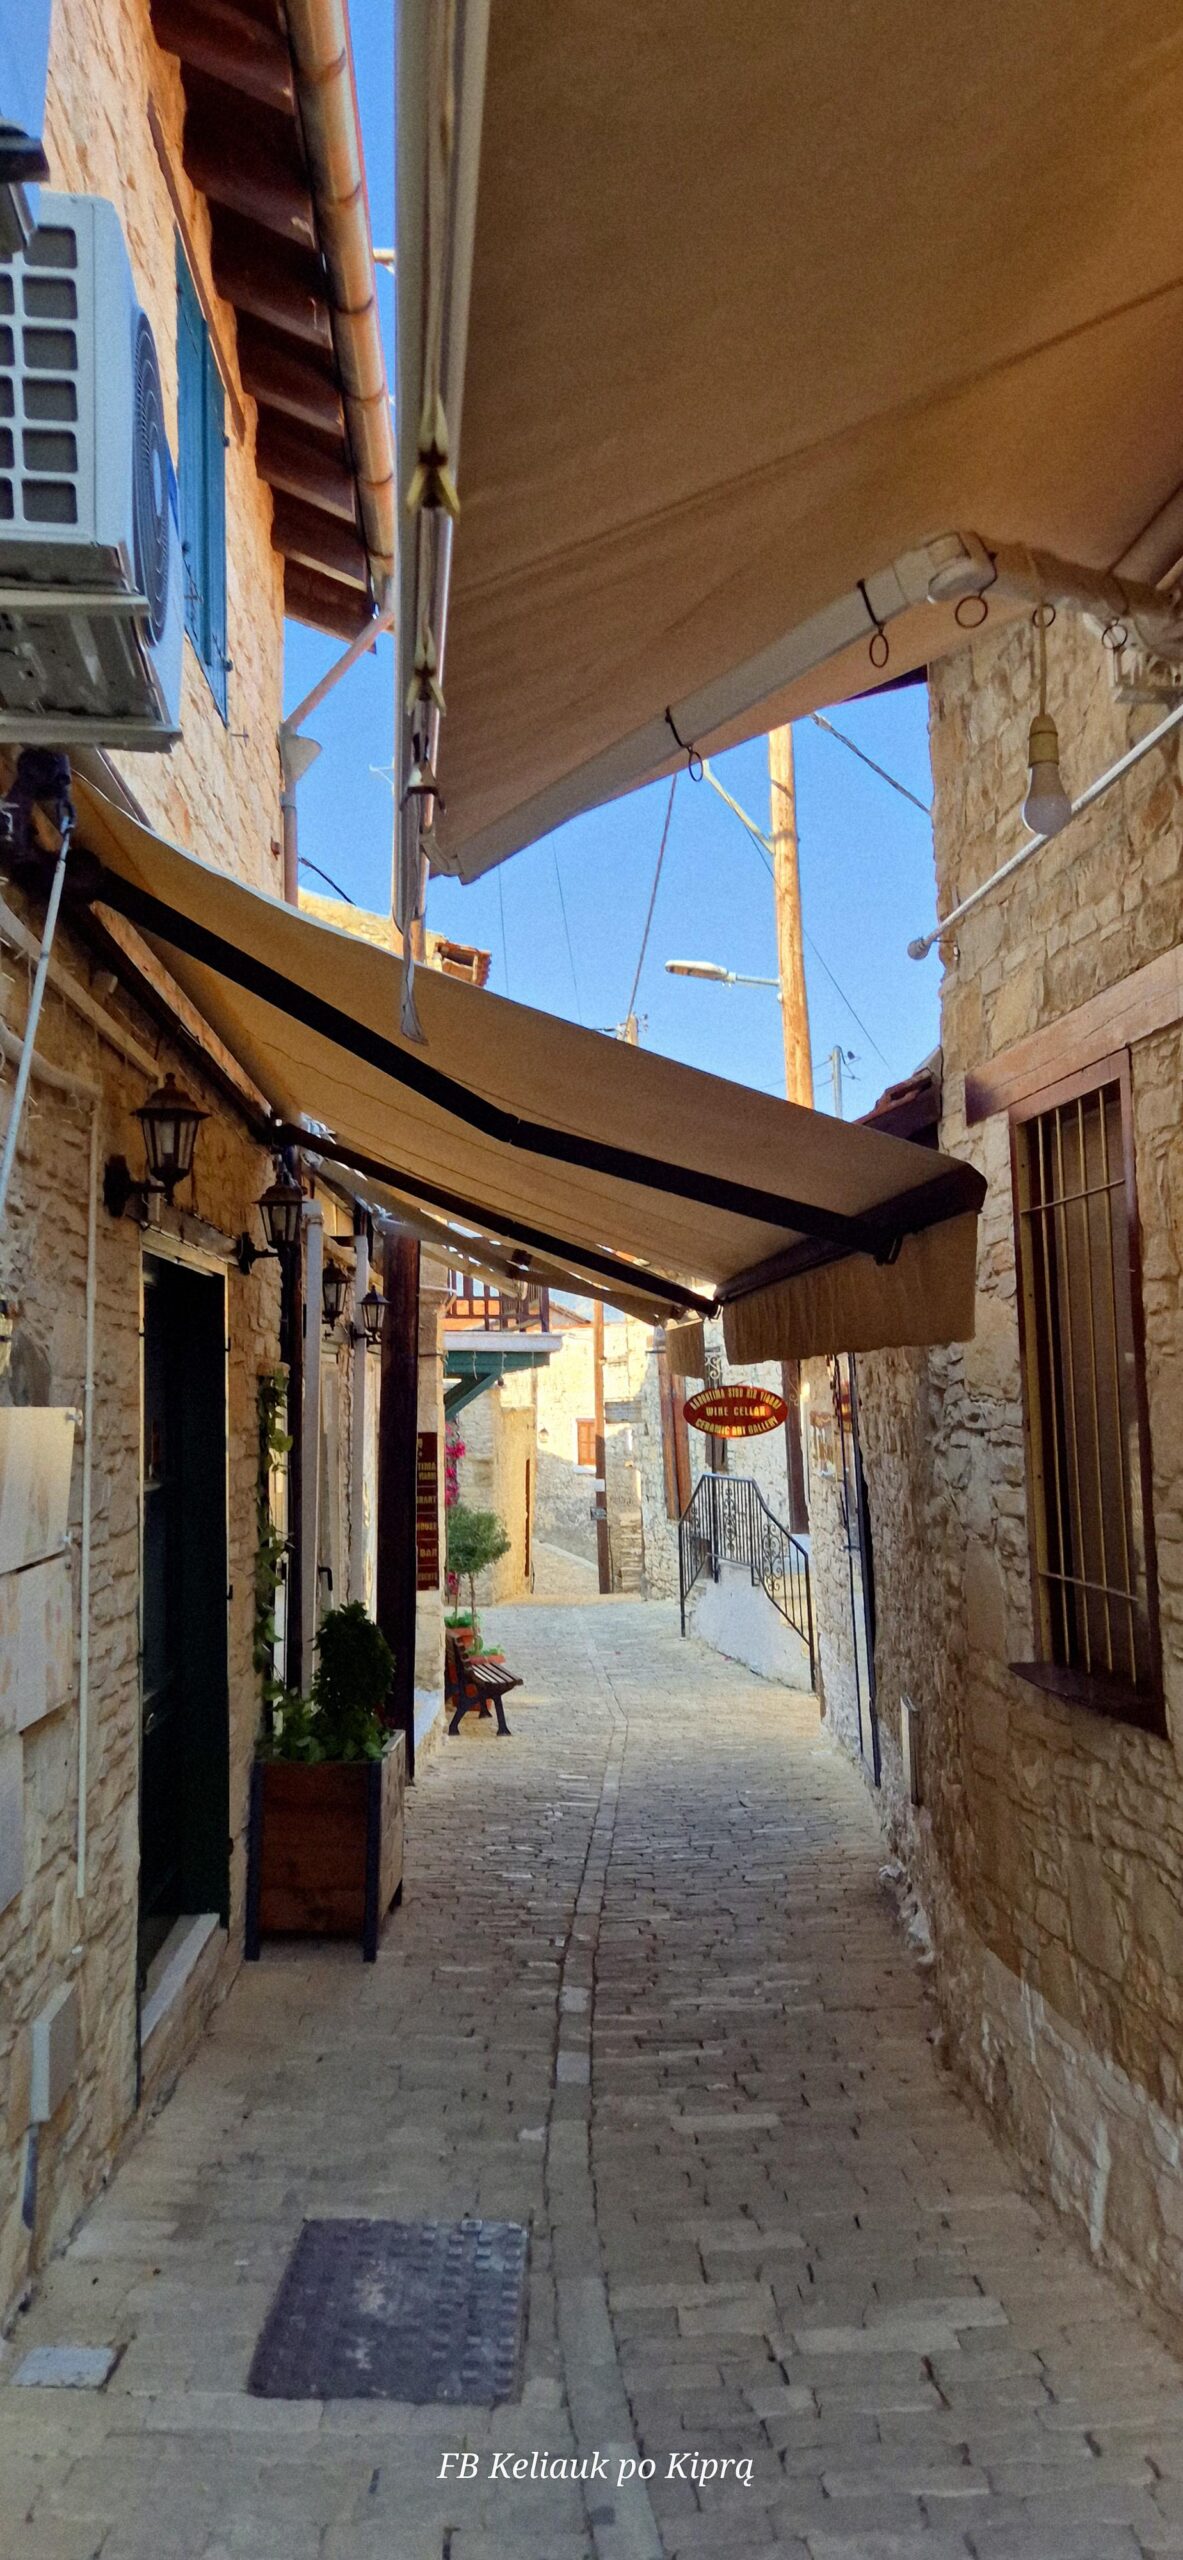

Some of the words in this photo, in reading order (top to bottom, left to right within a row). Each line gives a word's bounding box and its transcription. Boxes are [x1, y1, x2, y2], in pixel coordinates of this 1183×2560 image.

[706, 1407, 728, 1416] WINE
[733, 1406, 766, 1416] CELLAR
[695, 1418, 730, 1435] CERAMIC
[731, 1425, 746, 1435] ART
[747, 1416, 778, 1434] GALLERY
